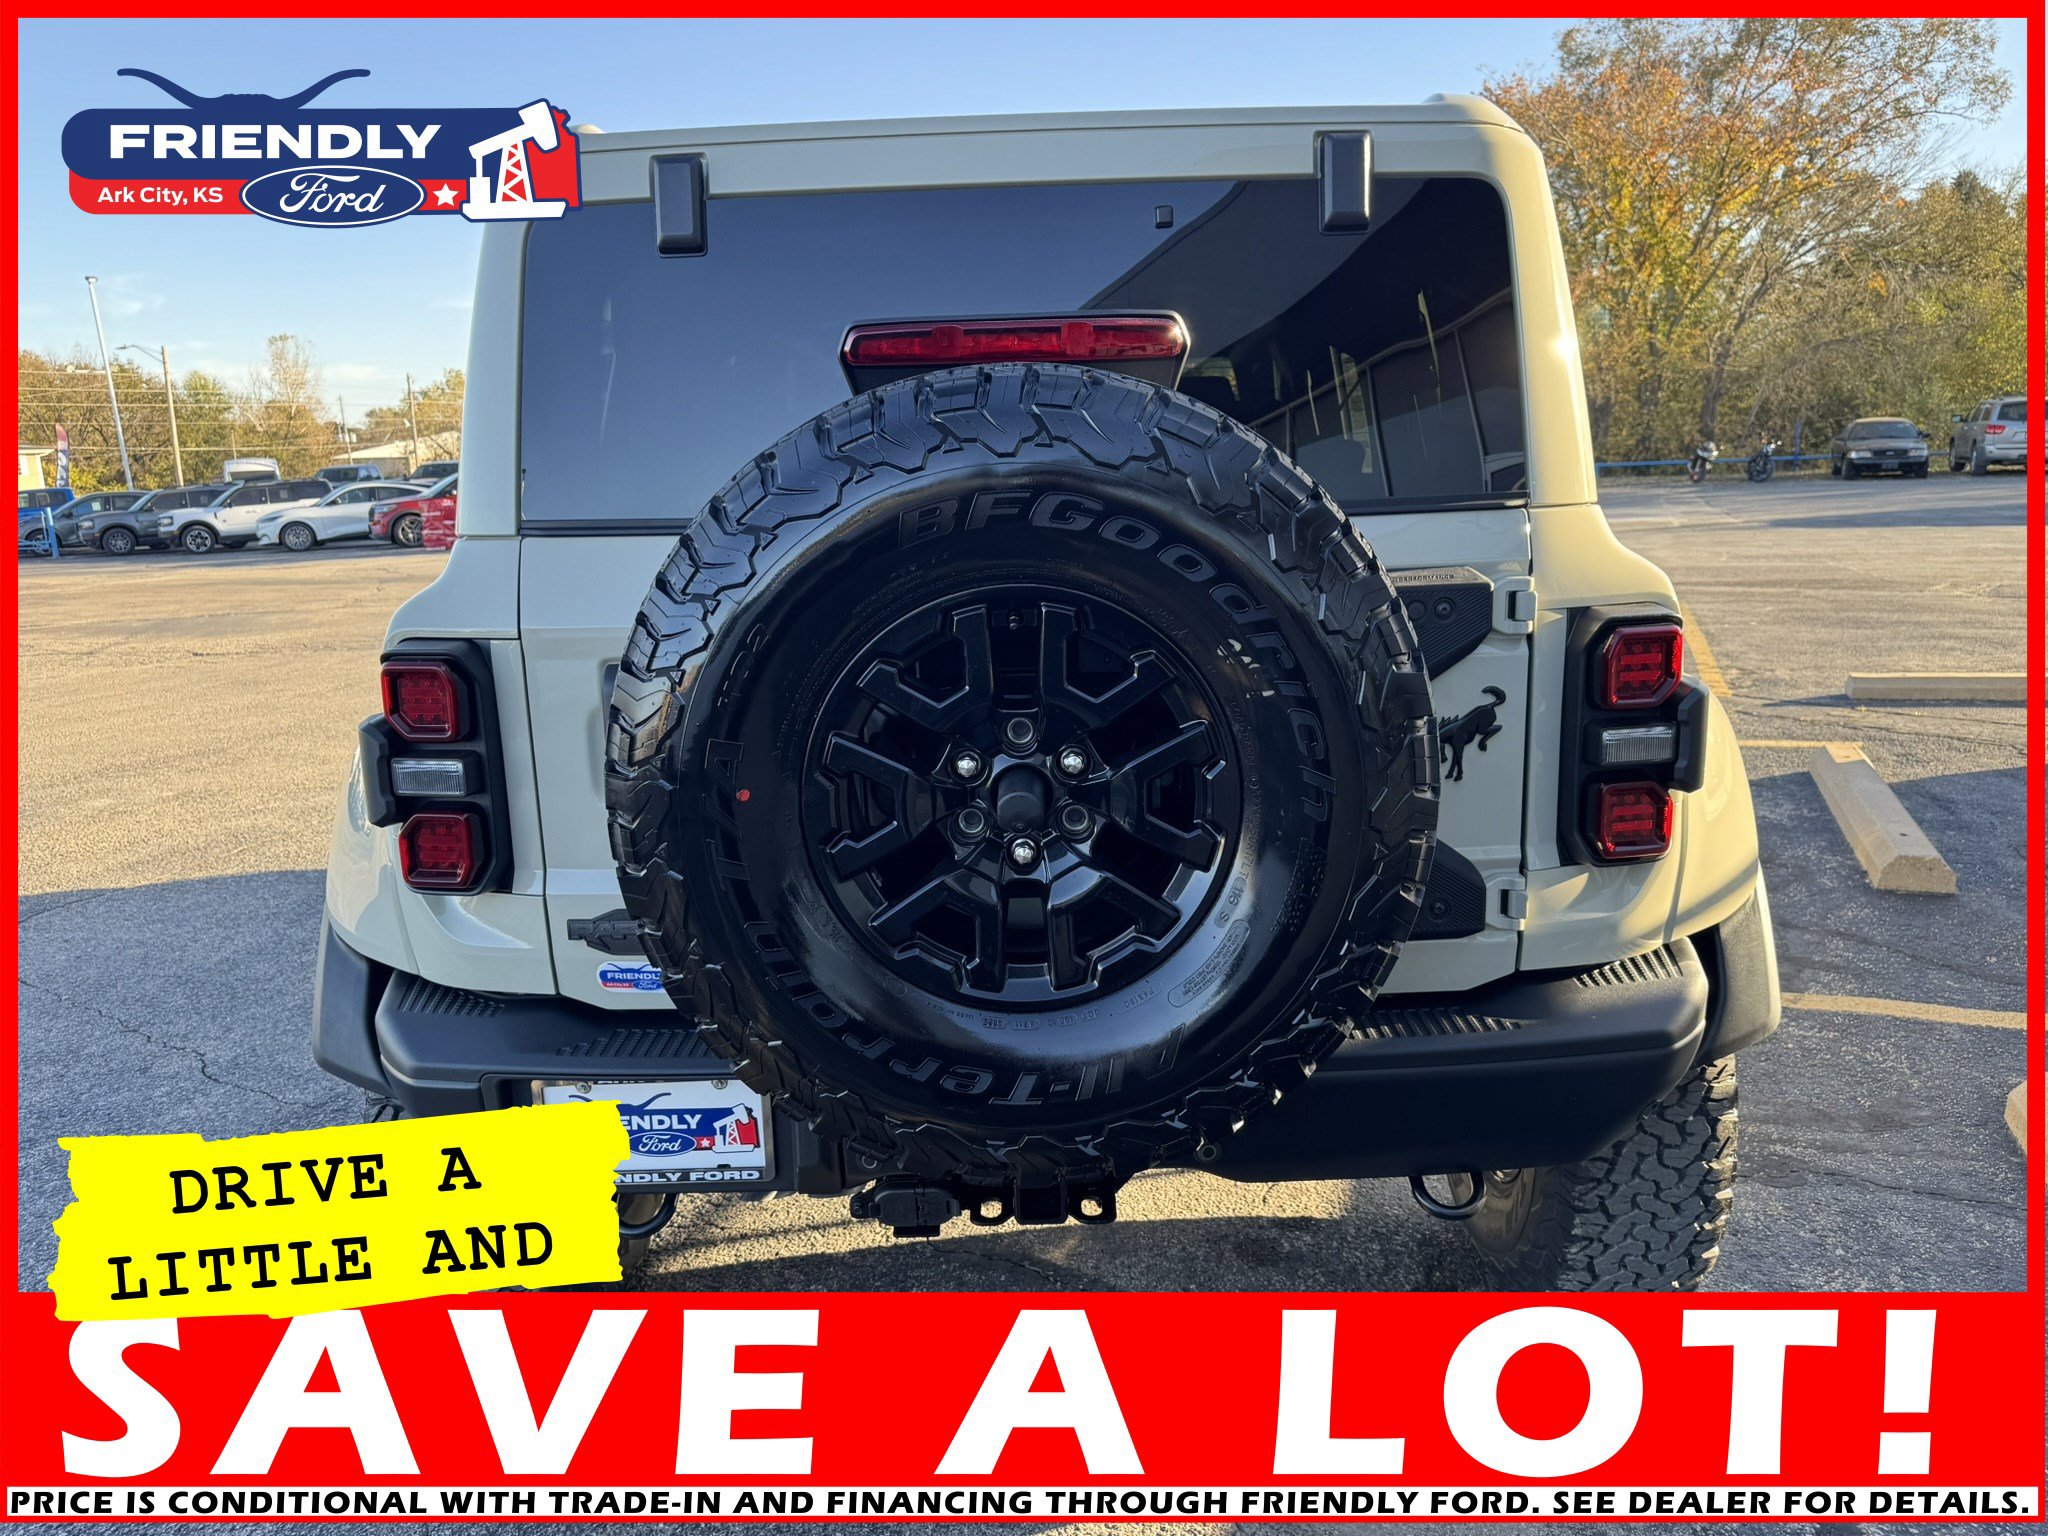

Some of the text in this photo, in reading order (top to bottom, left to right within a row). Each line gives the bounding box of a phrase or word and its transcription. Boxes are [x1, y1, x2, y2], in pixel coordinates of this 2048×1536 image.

[898, 489, 1337, 822] BFGoodrich
[606, 972, 660, 980] FRIENDL
[638, 980, 658, 989] Ford
[743, 920, 1187, 1105] All-Terrain
[619, 1113, 702, 1131] ENDLY
[637, 1134, 682, 1152] Ford
[617, 1169, 760, 1184] NDLY FORD
